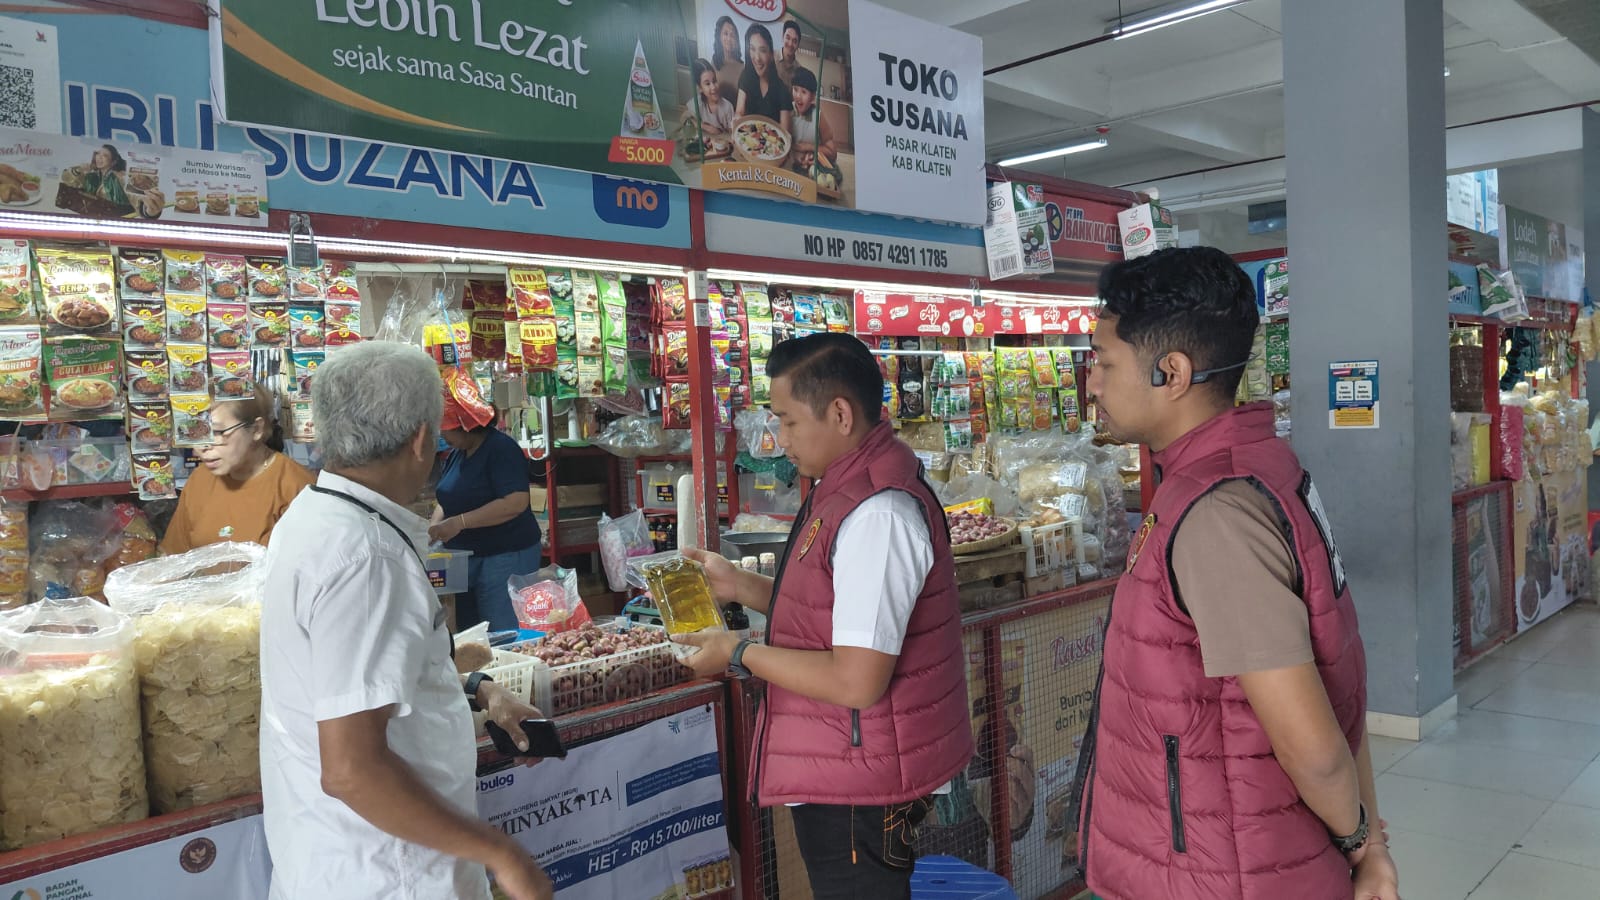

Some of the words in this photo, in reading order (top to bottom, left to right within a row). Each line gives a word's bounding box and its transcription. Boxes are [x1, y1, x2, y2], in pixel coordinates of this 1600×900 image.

[471, 0, 590, 75] Lezat
[332, 44, 393, 75] sejak
[396, 55, 456, 81] sama
[459, 61, 506, 92] Sasa
[510, 72, 579, 110] Santan
[878, 52, 959, 102] TOKO
[870, 95, 968, 141] SUSANA
[626, 146, 665, 163] 5.000
[885, 135, 922, 155] PASAR
[920, 143, 957, 162] KLATEN
[186, 160, 214, 169] Bumbu
[215, 163, 247, 172] Warisan
[198, 168, 220, 177] Masa
[892, 156, 914, 170] KAB
[915, 159, 952, 177] KLATEN
[718, 167, 753, 183] Kental
[754, 169, 764, 182] &
[764, 170, 803, 196] Creamy
[1065, 219, 1094, 242] BANK
[1513, 218, 1537, 246] Lodeh
[803, 233, 824, 256] NO
[827, 237, 846, 259] HP
[852, 239, 884, 261] 0857
[887, 244, 916, 266] 4291
[919, 247, 948, 268] 1785
[514, 273, 545, 283] AIDA
[523, 327, 554, 338] AIDA
[480, 773, 515, 792] bulog
[588, 848, 619, 874] HET
[630, 812, 722, 857] Rp15.700/liter
[45, 878, 78, 893] BADAN
[46, 885, 85, 900] PANGAN
